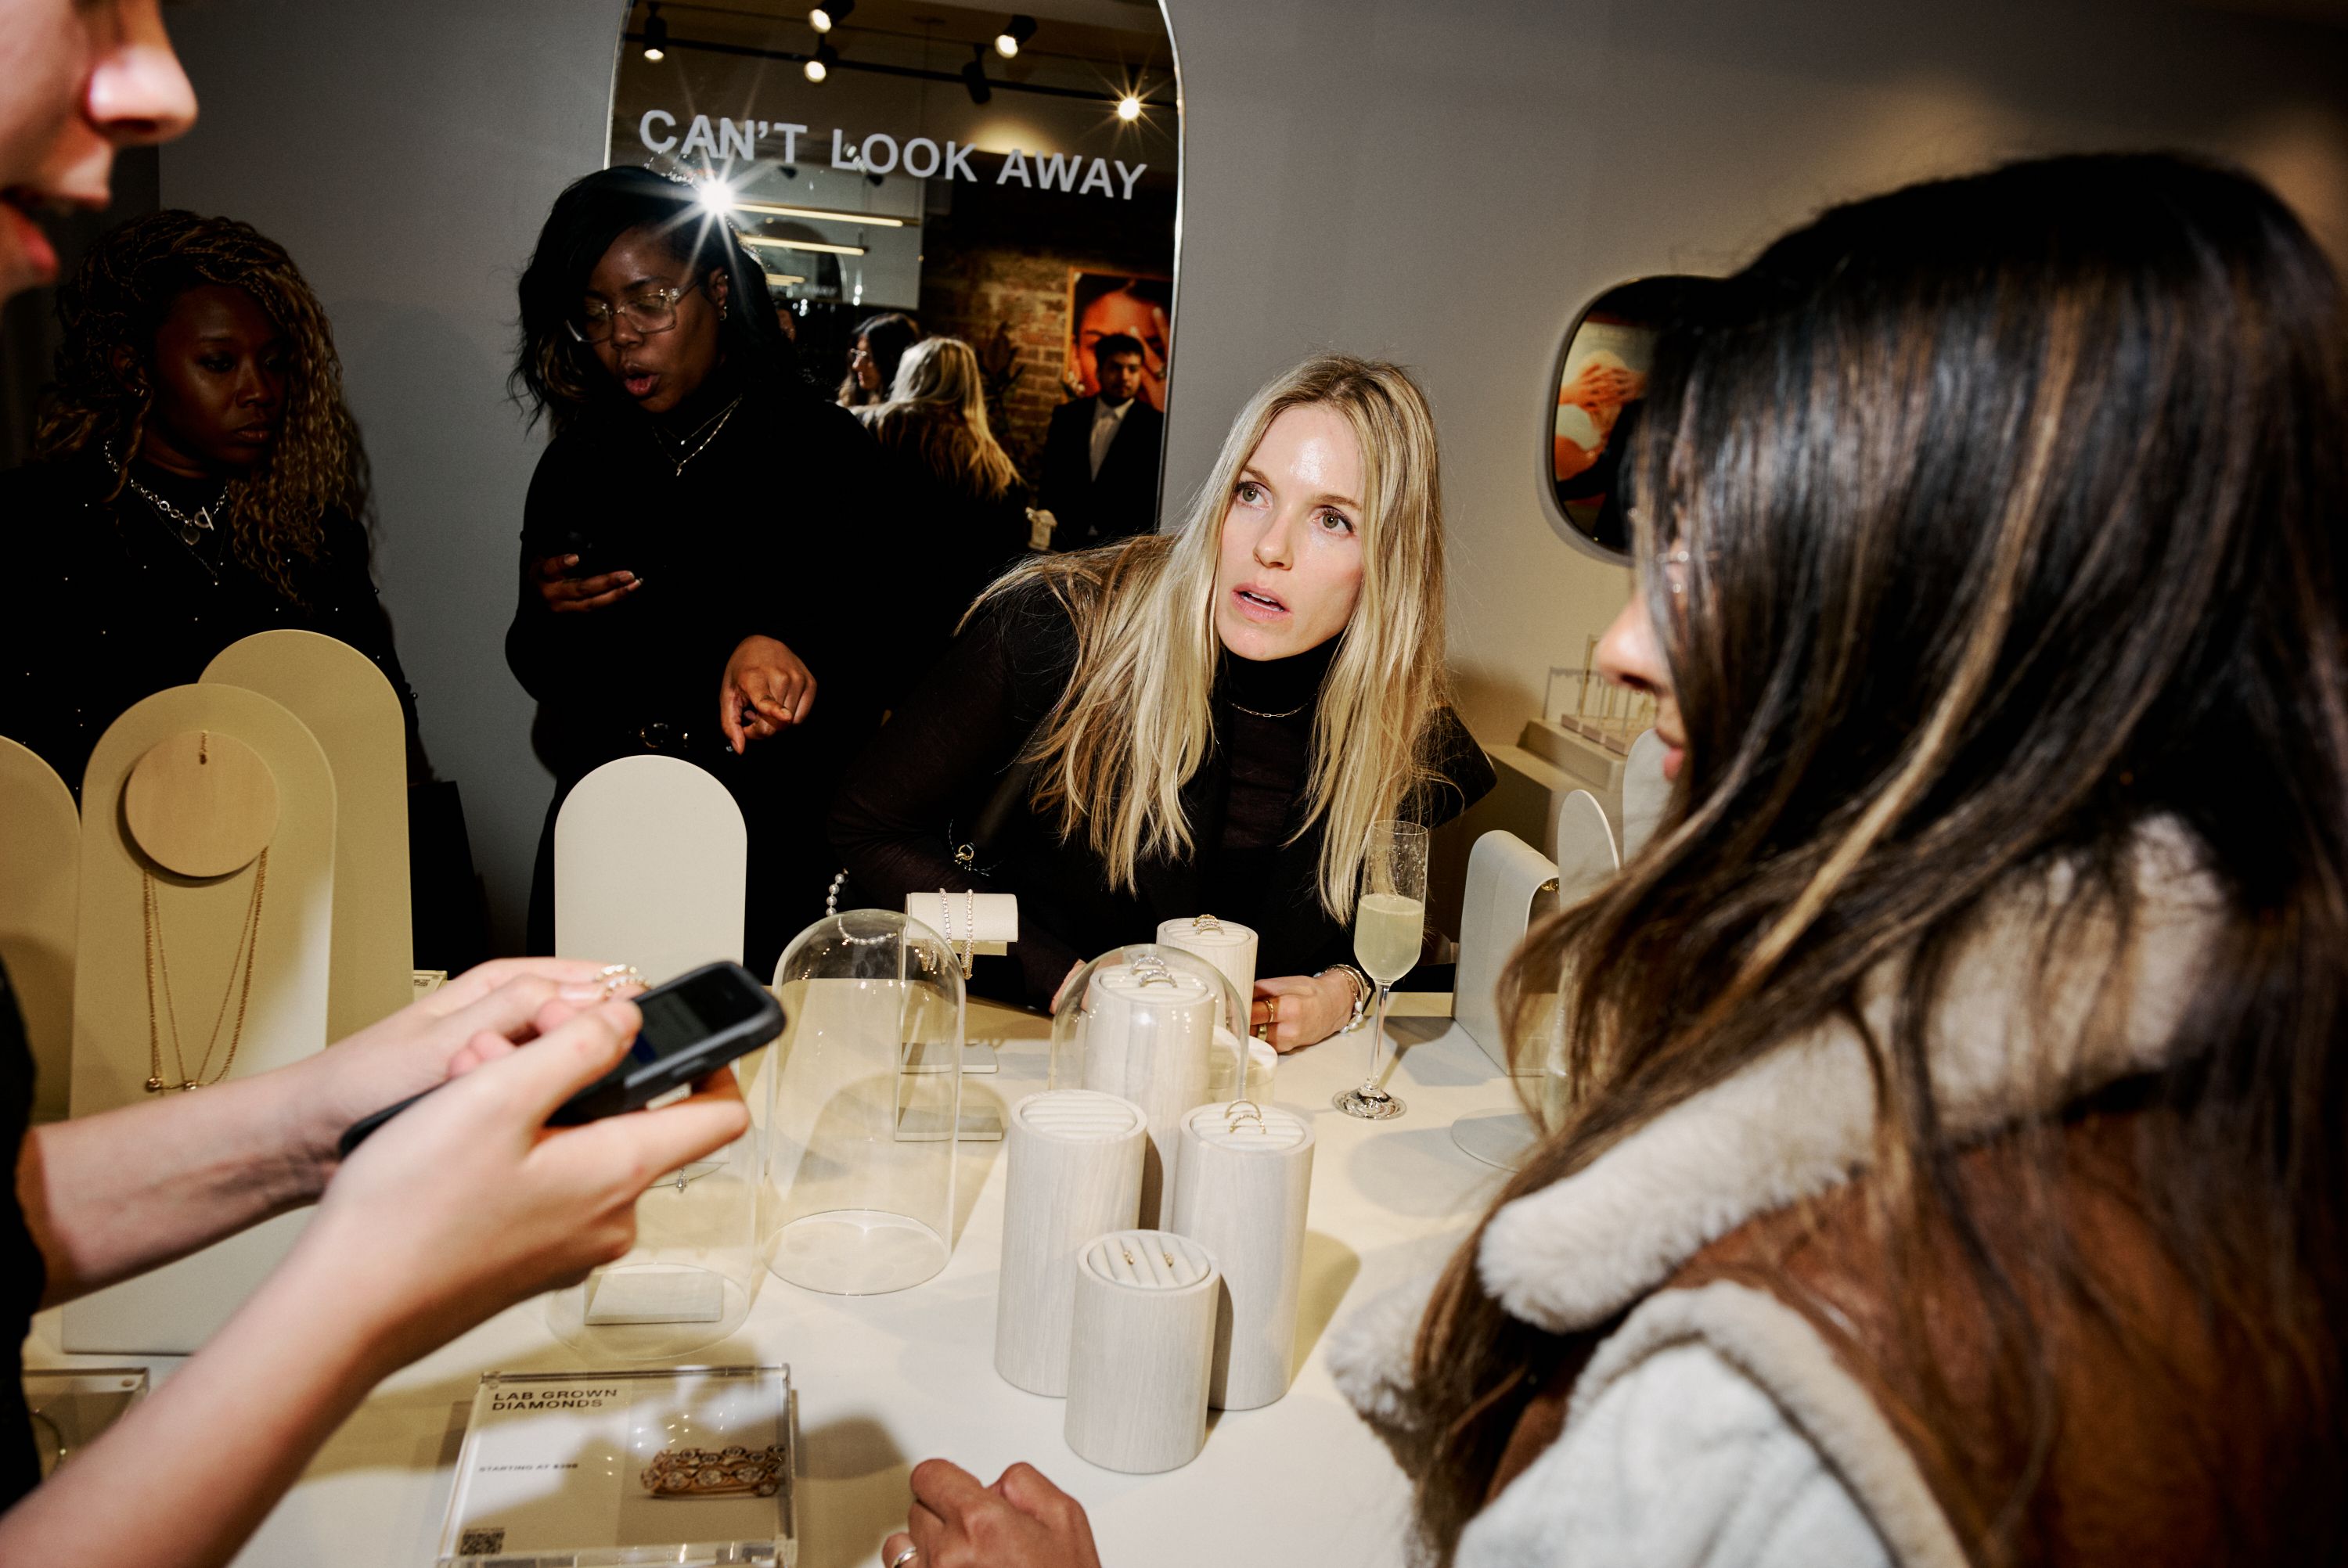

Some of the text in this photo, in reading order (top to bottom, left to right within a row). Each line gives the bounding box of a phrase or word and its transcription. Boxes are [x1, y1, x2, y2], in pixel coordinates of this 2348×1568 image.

[639, 110, 1147, 200] CAN’T LOOK AWAY
[495, 1390, 617, 1401] LAB GROWN
[492, 1400, 602, 1411] DIAMONDS
